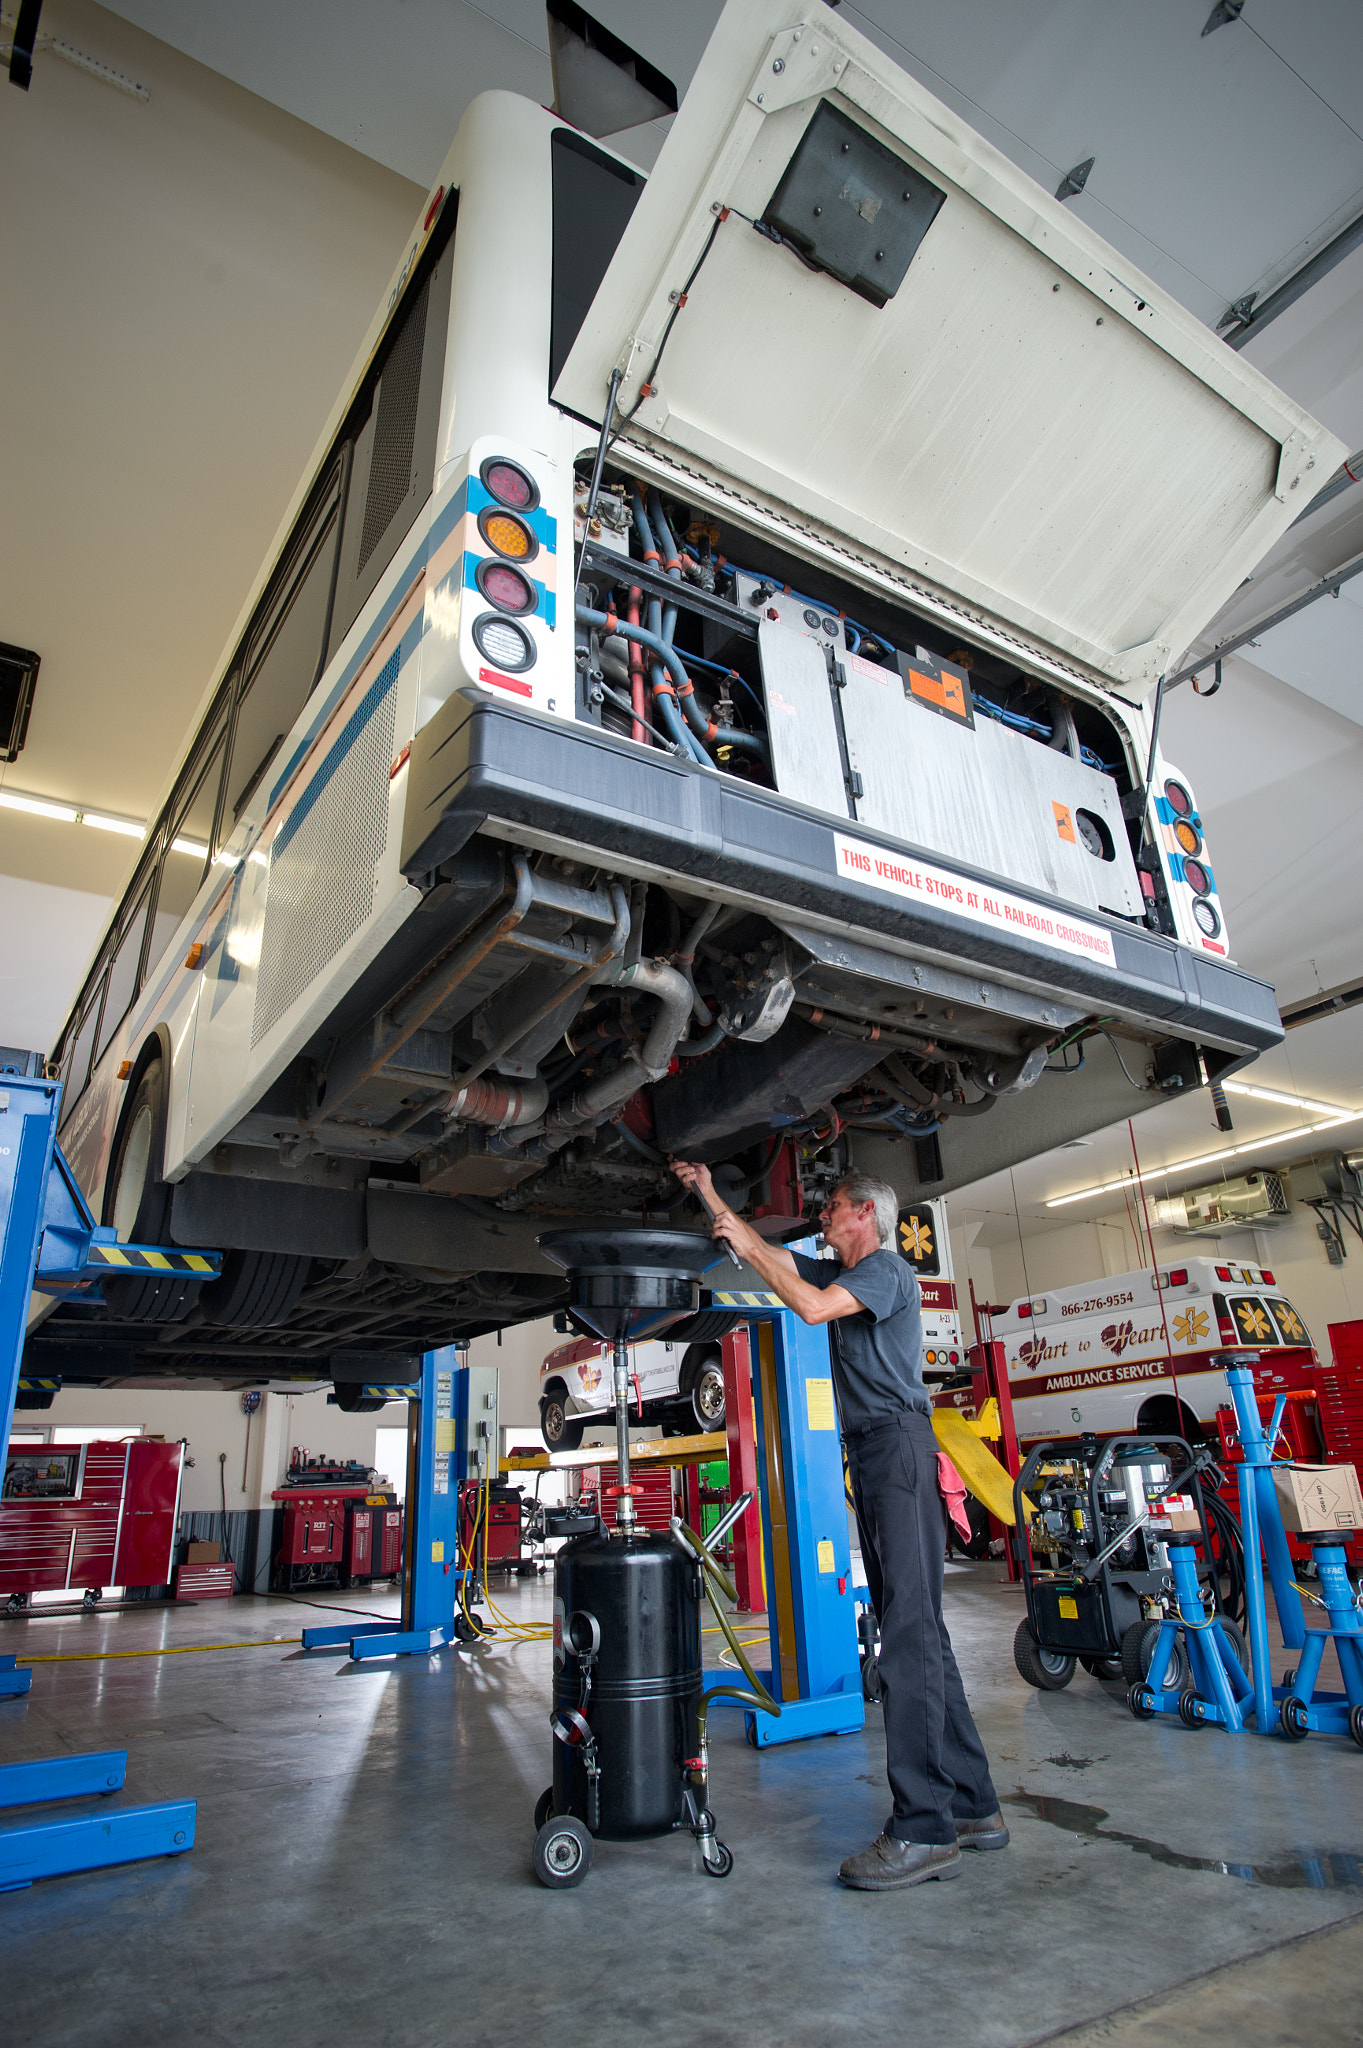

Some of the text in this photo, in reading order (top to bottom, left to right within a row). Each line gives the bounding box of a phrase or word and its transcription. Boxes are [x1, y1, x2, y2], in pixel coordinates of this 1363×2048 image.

[841, 848, 1110, 956] THIS VEHICLE STOPS AT ALL RAILROAD CROSSINGS
[918, 1283, 939, 1301] eart
[1061, 1291, 1134, 1317] 866-276-9554
[1018, 1321, 1167, 1366] Hart to Heart
[1046, 1361, 1165, 1391] AMBULANCE SERVICE
[1316, 1485, 1327, 1513] UN 1950
[313, 1521, 326, 1529] RTI
